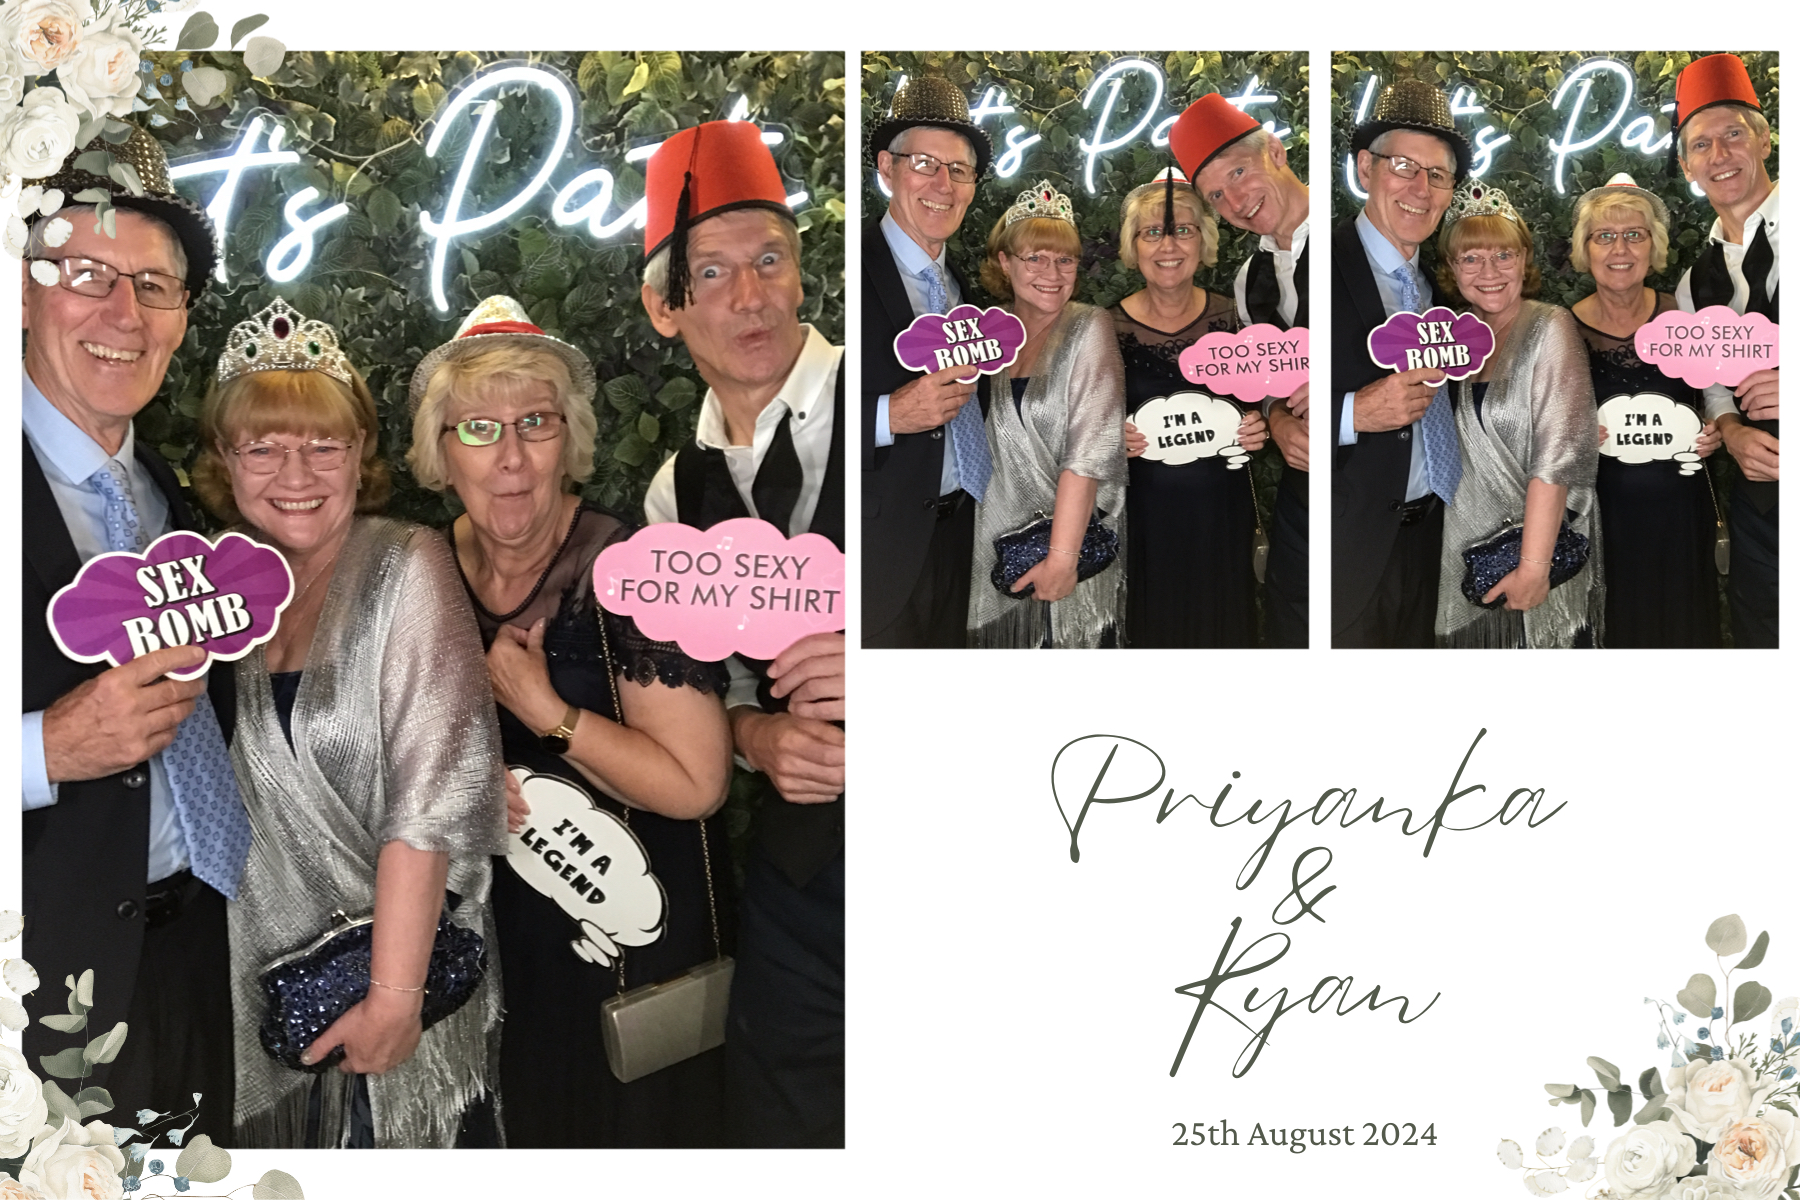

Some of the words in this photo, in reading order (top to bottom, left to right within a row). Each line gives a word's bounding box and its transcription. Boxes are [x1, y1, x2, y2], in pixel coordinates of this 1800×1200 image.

[942, 317, 985, 345] SEX
[1416, 321, 1456, 345] SEX
[1665, 325, 1705, 340] TOO
[1711, 325, 1754, 340] SEXY
[933, 338, 1003, 371] BOMB
[1208, 344, 1250, 360] TOO
[1256, 340, 1299, 356] SEXY
[1405, 344, 1471, 371] BOMB
[1650, 343, 1683, 357] FOR
[1689, 343, 1715, 357] MY
[1721, 343, 1773, 358] SHIRT
[1195, 362, 1230, 377] FOR
[1236, 360, 1262, 374] MY
[1268, 356, 1309, 372] SHIR
[1163, 414, 1186, 428] I'M
[1191, 411, 1202, 424] A
[1625, 413, 1647, 426] I'M
[1652, 413, 1662, 426] A
[1158, 429, 1215, 448] LEGEND
[1617, 433, 1673, 445] LEGEND
[651, 549, 722, 576] TOO
[734, 553, 811, 580] SEXY
[136, 554, 216, 608] SEX
[620, 579, 680, 604] FOR
[690, 583, 739, 607] MY
[750, 586, 841, 614] SHIRT
[122, 592, 253, 658] BOMB
[552, 818, 594, 856] I'M
[590, 855, 612, 876] A
[519, 827, 606, 905] LEGEND
